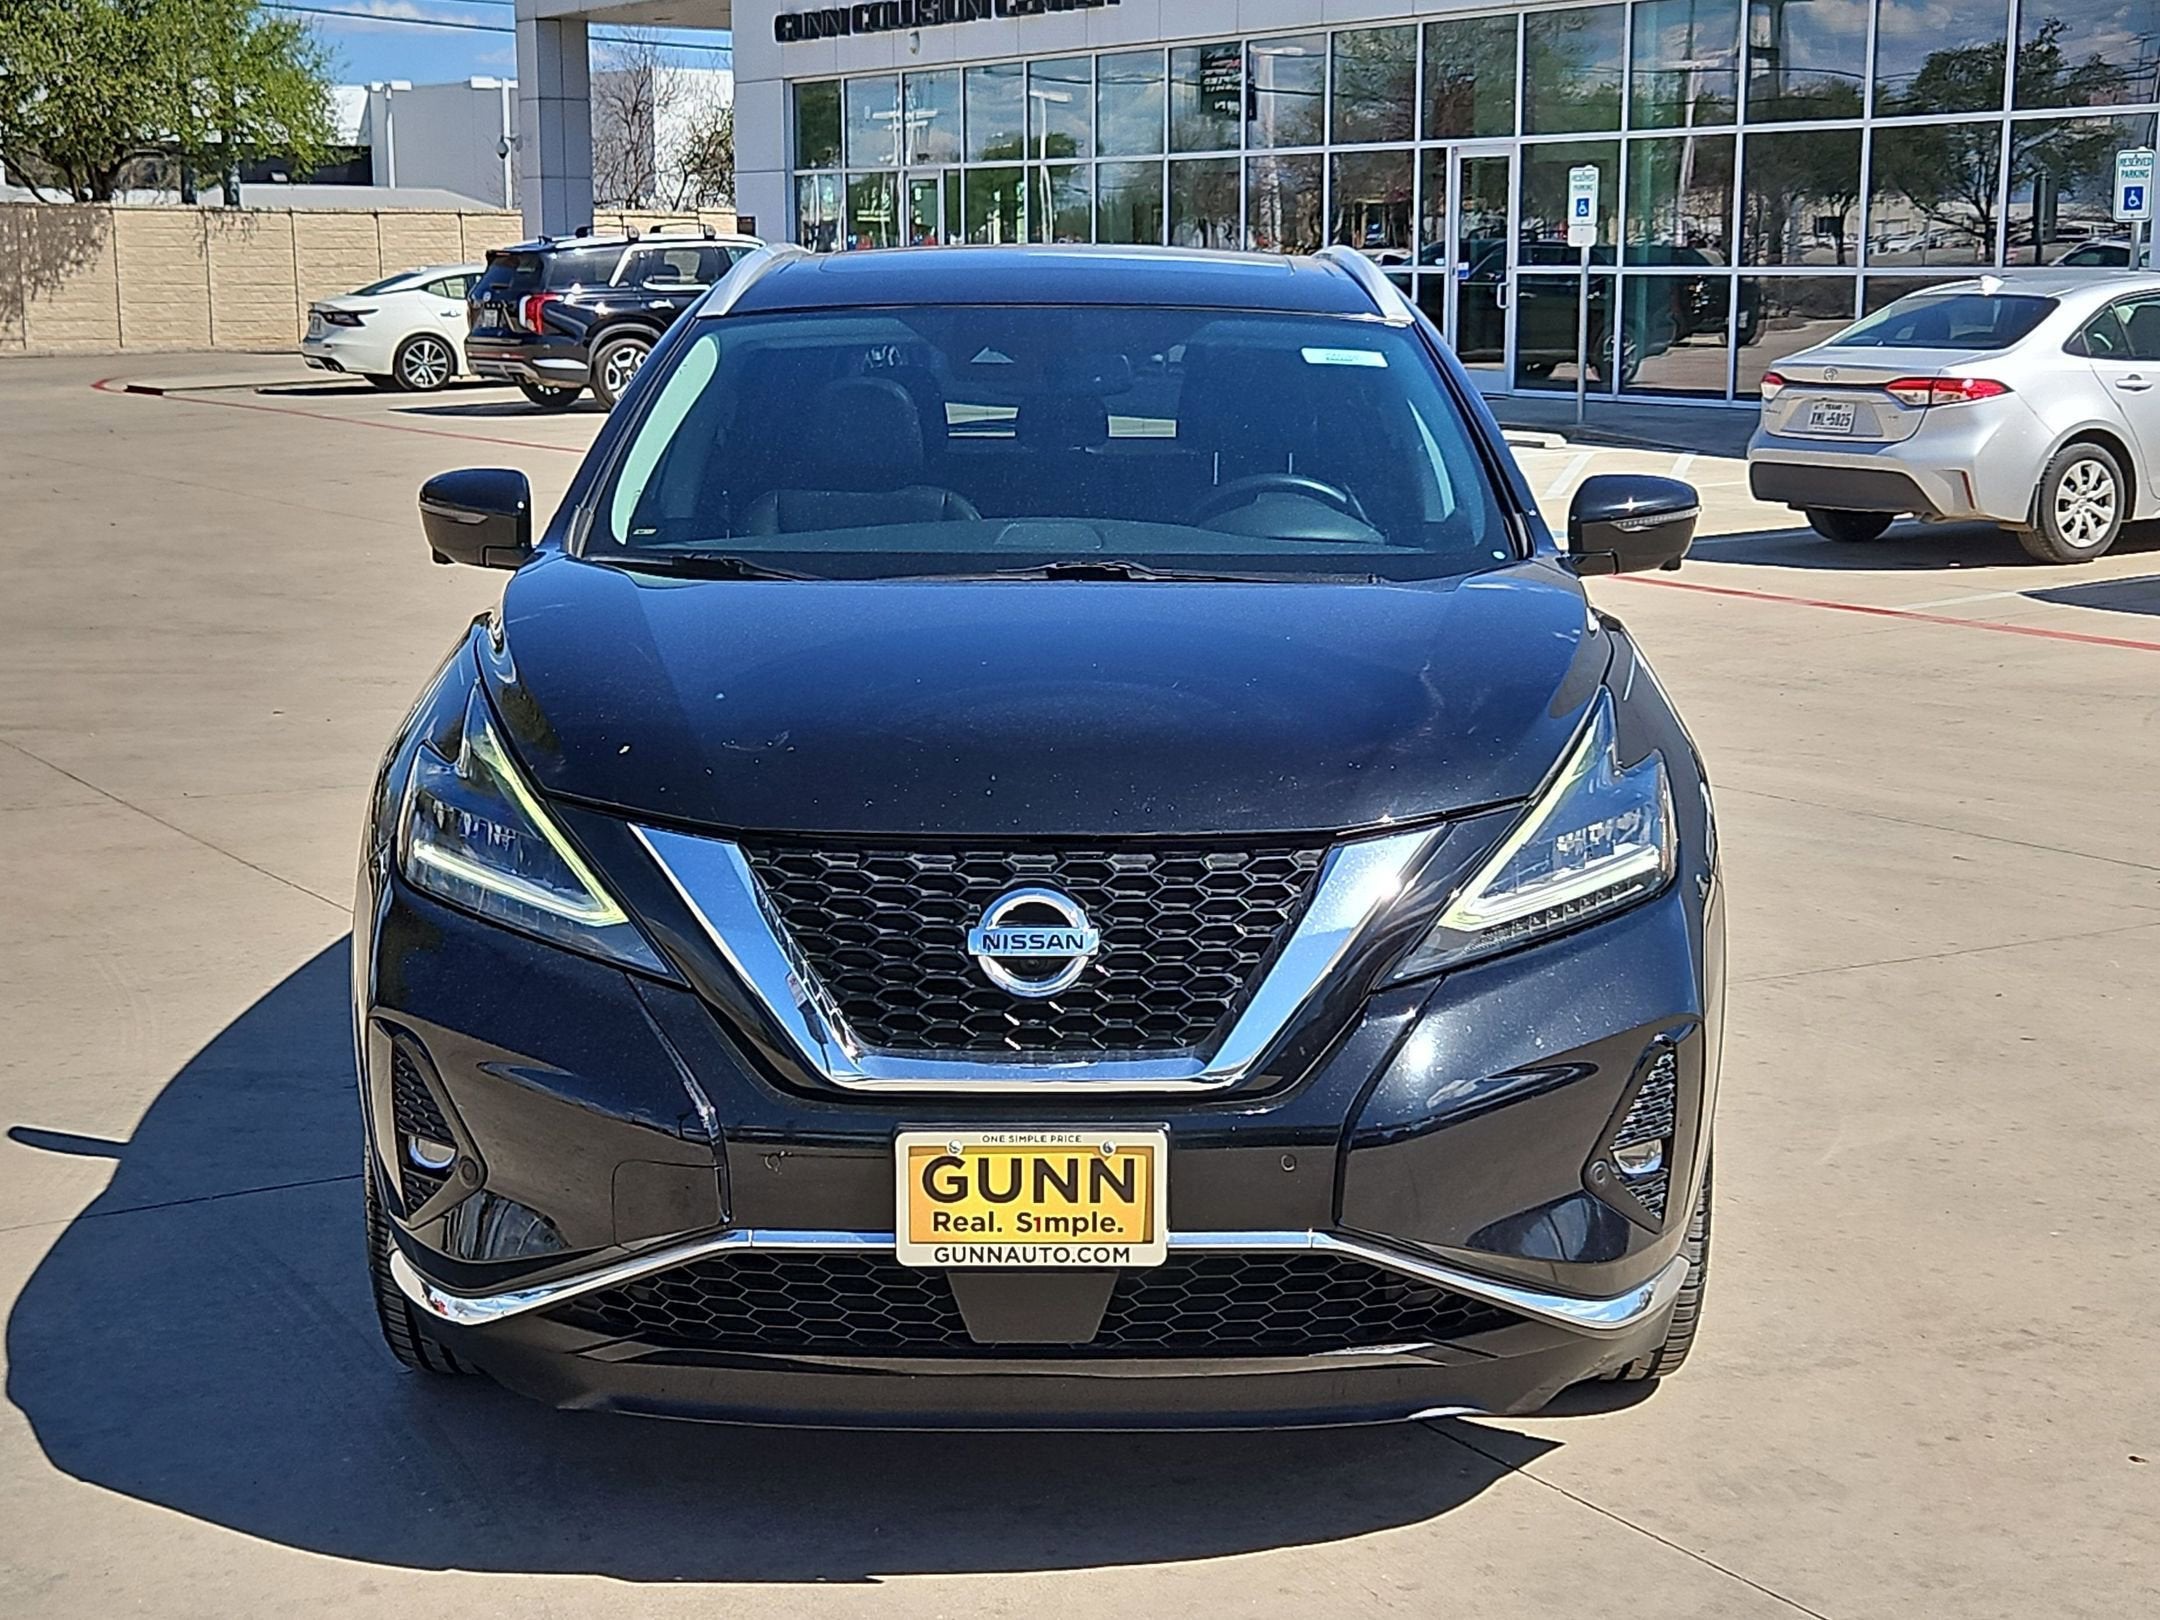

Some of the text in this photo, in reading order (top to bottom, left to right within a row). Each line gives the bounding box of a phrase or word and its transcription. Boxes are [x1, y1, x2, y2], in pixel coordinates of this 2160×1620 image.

[983, 934, 1084, 950] NISSAN
[982, 1134, 1083, 1143] ONE SIMPLE PRICE
[922, 1155, 1135, 1204] GUNN
[933, 1211, 1003, 1233] Real.
[934, 1246, 1130, 1264] GUNNAUTO.COM
